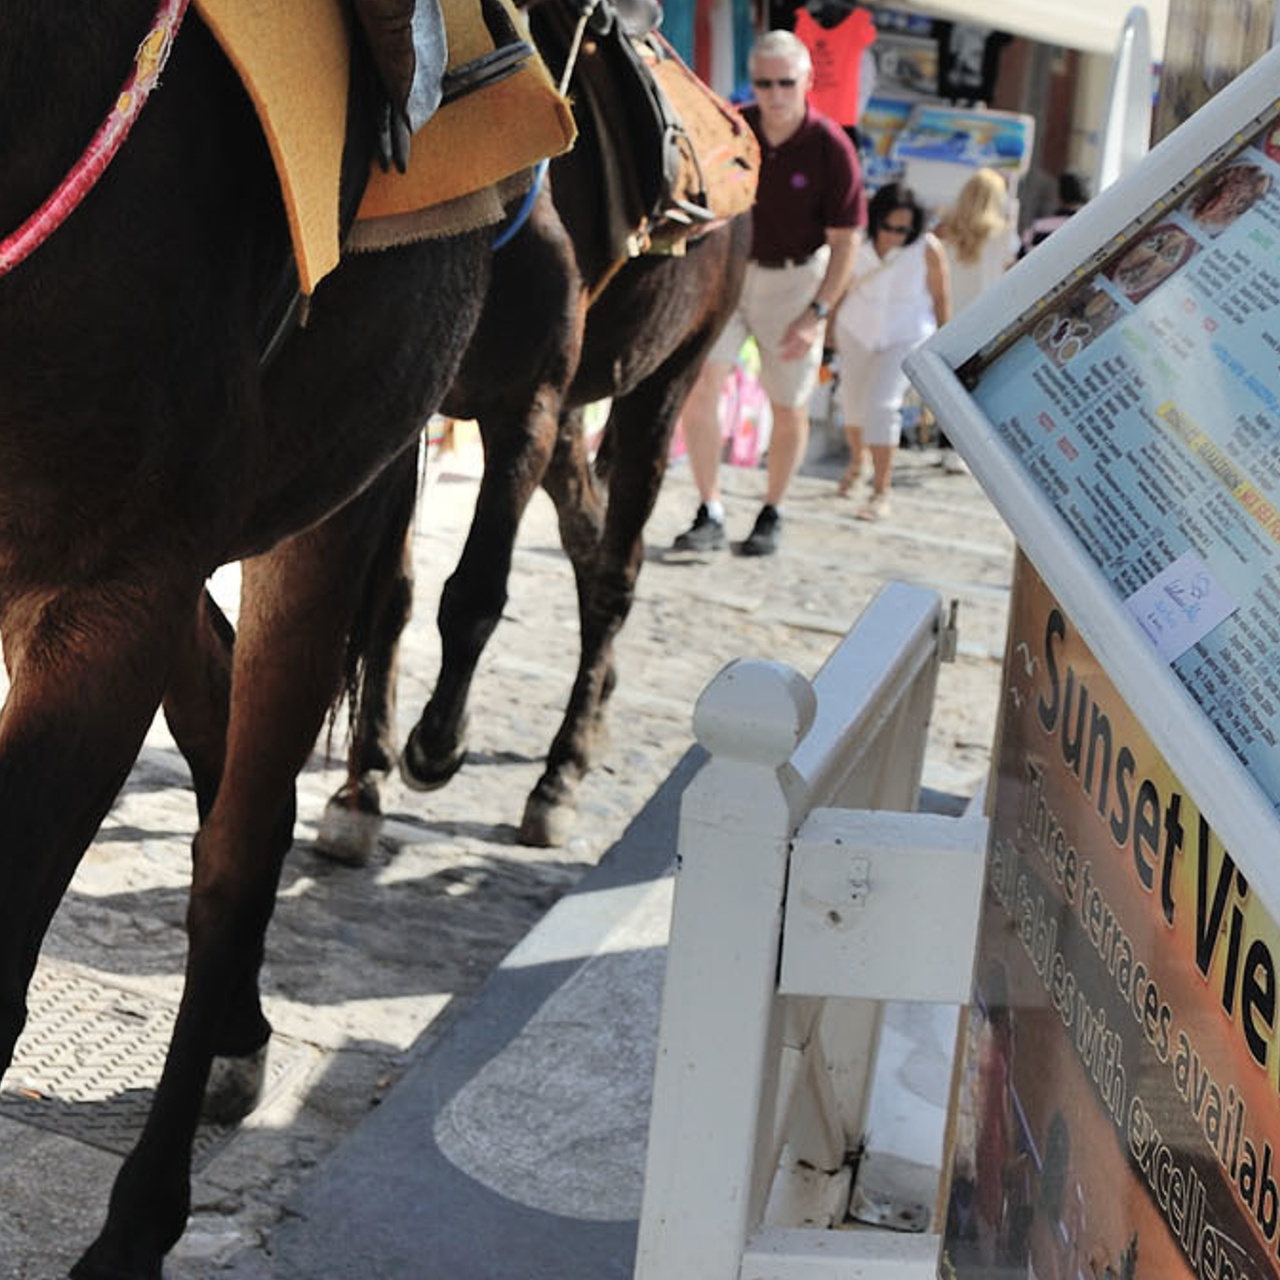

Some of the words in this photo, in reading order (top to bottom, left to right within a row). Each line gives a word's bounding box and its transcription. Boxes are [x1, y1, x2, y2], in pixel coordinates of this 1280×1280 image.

[1018, 871, 1077, 1027] tables
[1077, 992, 1126, 1127] with
[1127, 1096, 1250, 1280] excelle
[1022, 758, 1077, 905] Three
[1080, 860, 1171, 1063] terraces
[1174, 1029, 1280, 1246] availab
[1037, 609, 1184, 928] Sunset
[1195, 813, 1280, 1092] Vie
